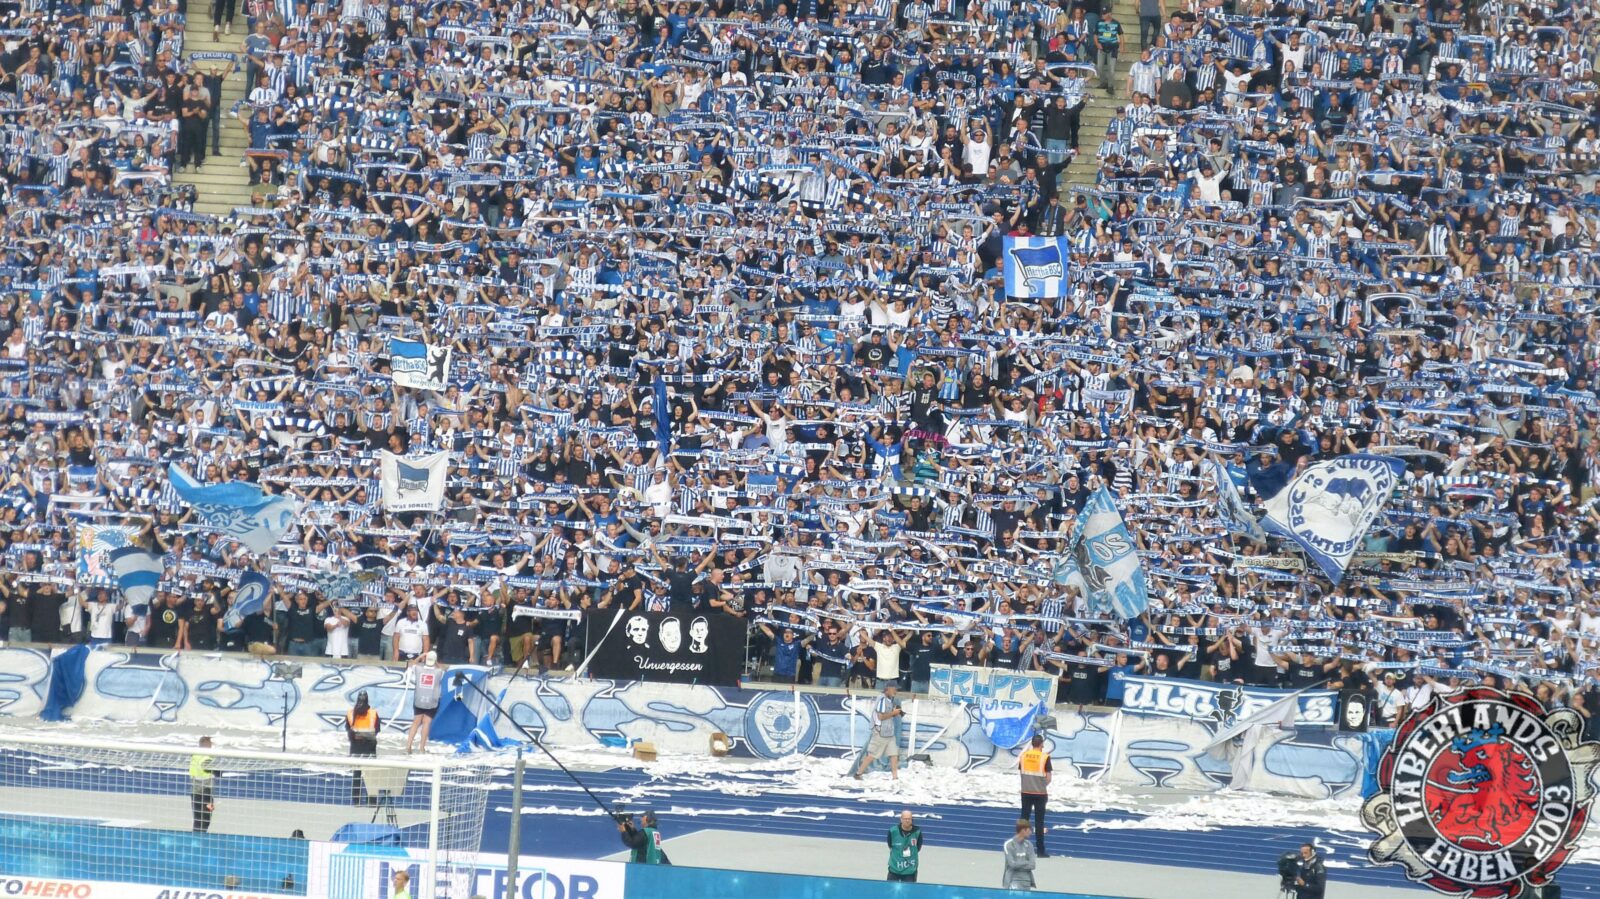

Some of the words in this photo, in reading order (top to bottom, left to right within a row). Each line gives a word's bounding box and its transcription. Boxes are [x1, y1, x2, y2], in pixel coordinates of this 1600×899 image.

[931, 202, 970, 210] OSTKURVE
[1026, 267, 1048, 277] Hertha
[1048, 264, 1060, 276] BSC
[155, 311, 180, 319] Hertha
[180, 311, 195, 319] BSC
[633, 655, 704, 675] Unvergessen
